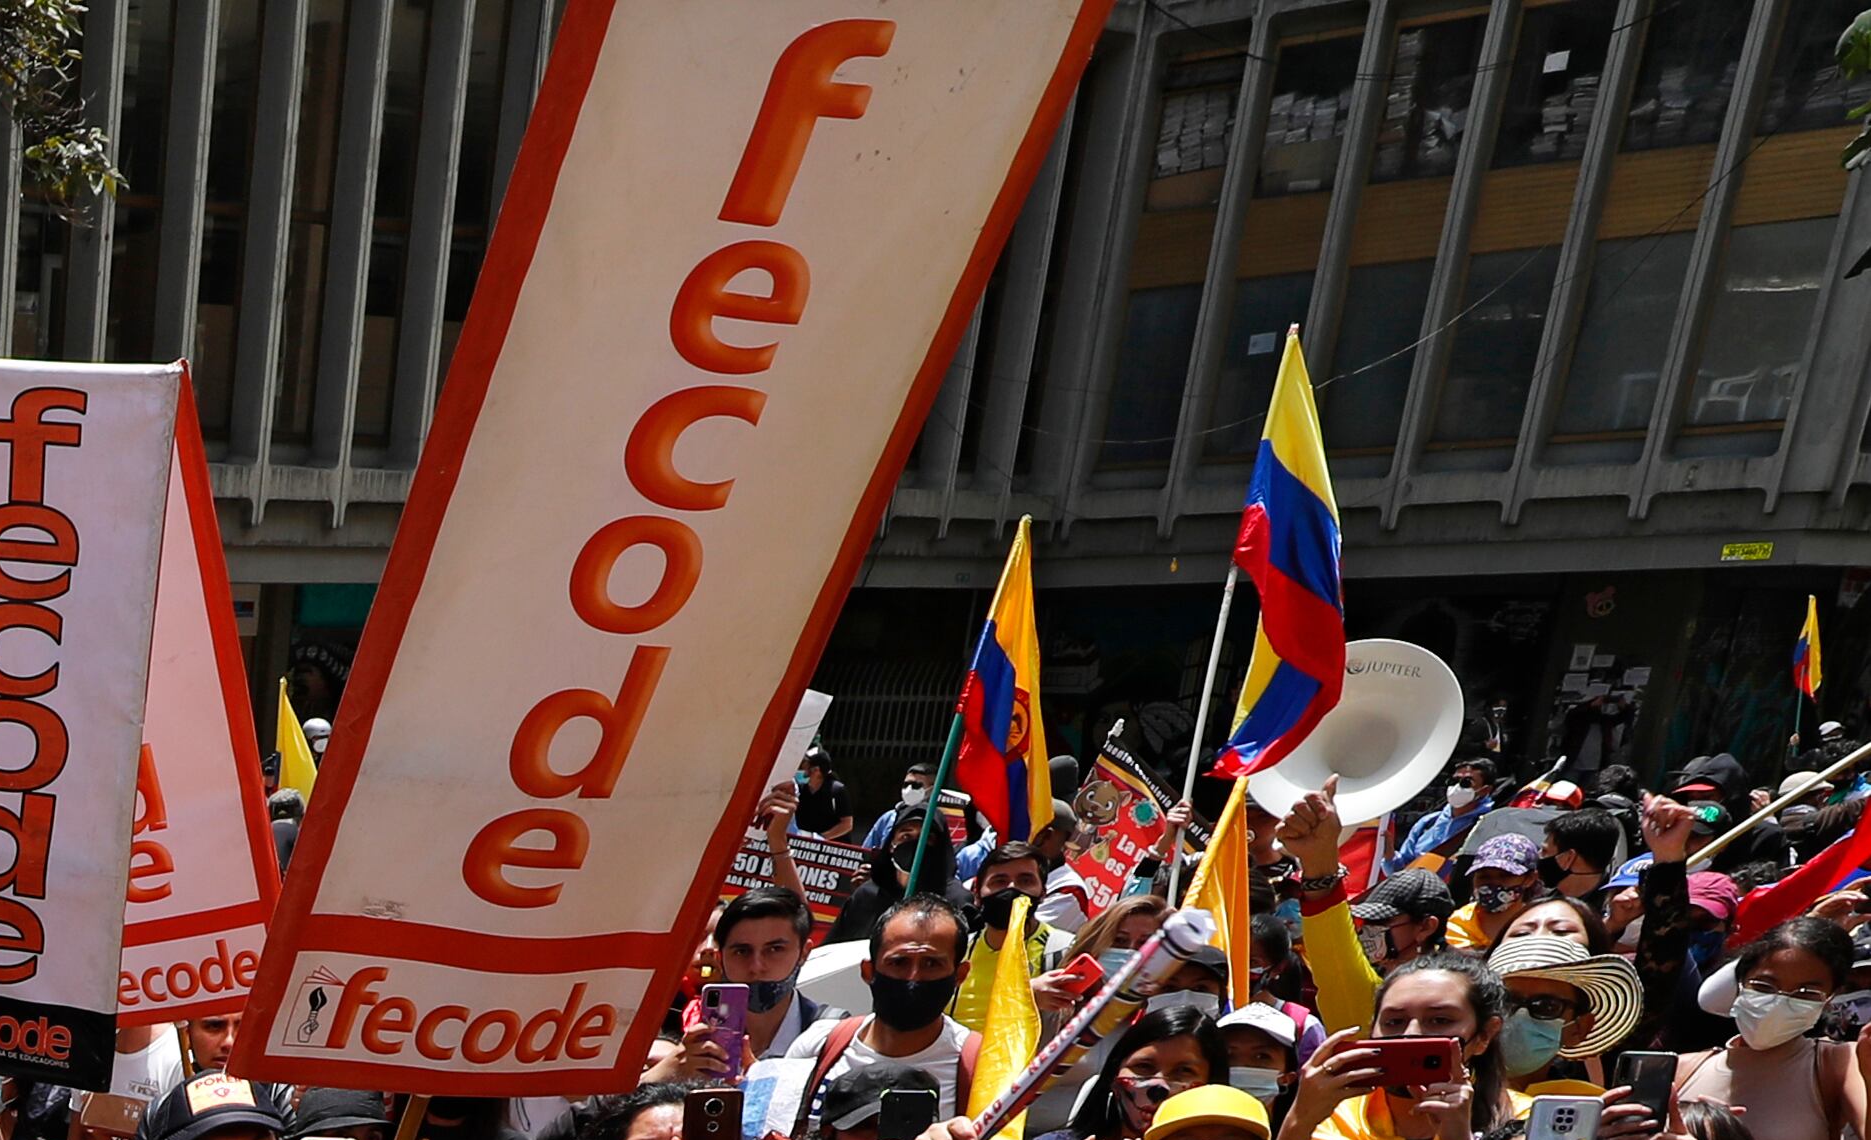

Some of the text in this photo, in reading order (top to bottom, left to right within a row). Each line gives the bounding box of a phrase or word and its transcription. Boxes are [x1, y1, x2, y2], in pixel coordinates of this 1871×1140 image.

[461, 18, 897, 910] fecode
[1364, 661, 1422, 678] JUPITER
[1116, 833, 1136, 857] La
[733, 851, 760, 874] 50
[1104, 857, 1126, 877] es
[724, 873, 743, 886] ADA
[118, 939, 259, 1006] ecode
[327, 965, 618, 1065] fecode
[7, 1050, 18, 1059] DE
[19, 1051, 70, 1069] EDUCADORES
